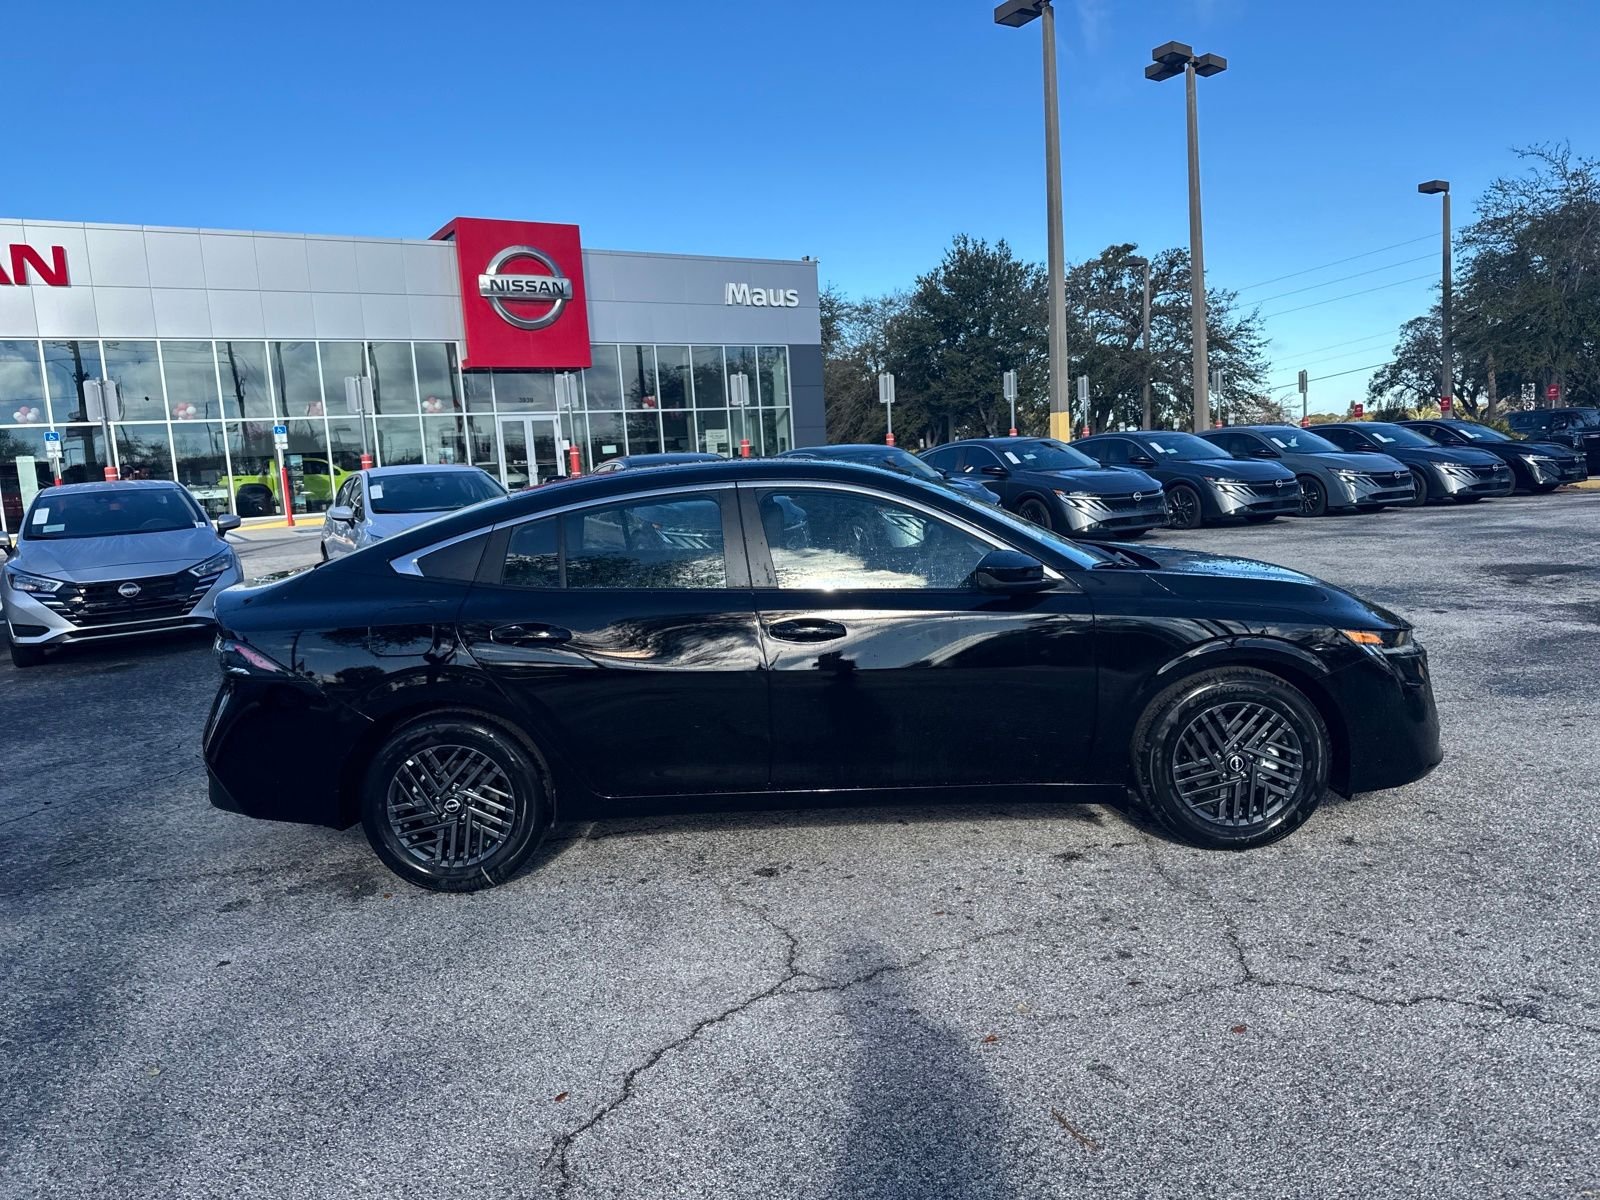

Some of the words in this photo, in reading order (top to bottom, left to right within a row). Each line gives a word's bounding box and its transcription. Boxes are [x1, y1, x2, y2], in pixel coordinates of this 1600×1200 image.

[0, 244, 70, 287] N
[489, 279, 565, 295] NISSAN
[725, 282, 800, 307] Maus
